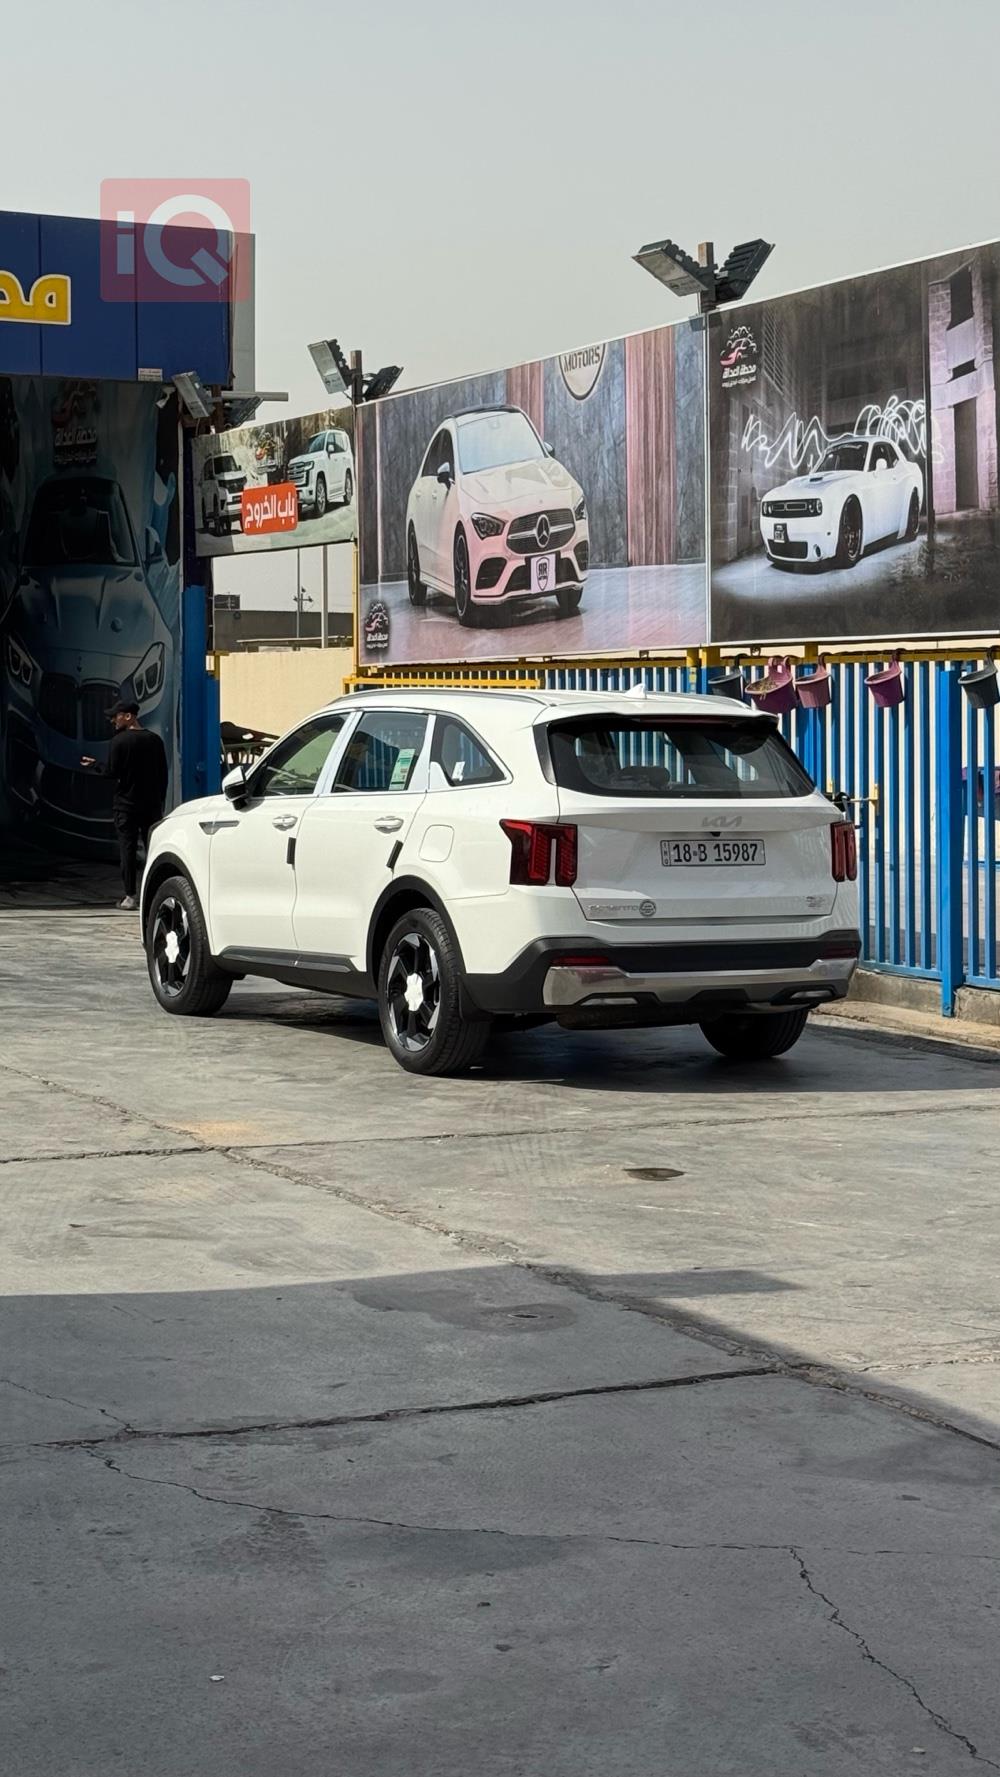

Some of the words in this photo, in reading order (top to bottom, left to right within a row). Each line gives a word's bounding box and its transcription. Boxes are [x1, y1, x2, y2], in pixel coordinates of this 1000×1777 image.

[564, 346, 601, 372] MOTORS
[244, 494, 277, 529] الخروج
[278, 491, 295, 525] باب
[713, 843, 758, 862] 15987
